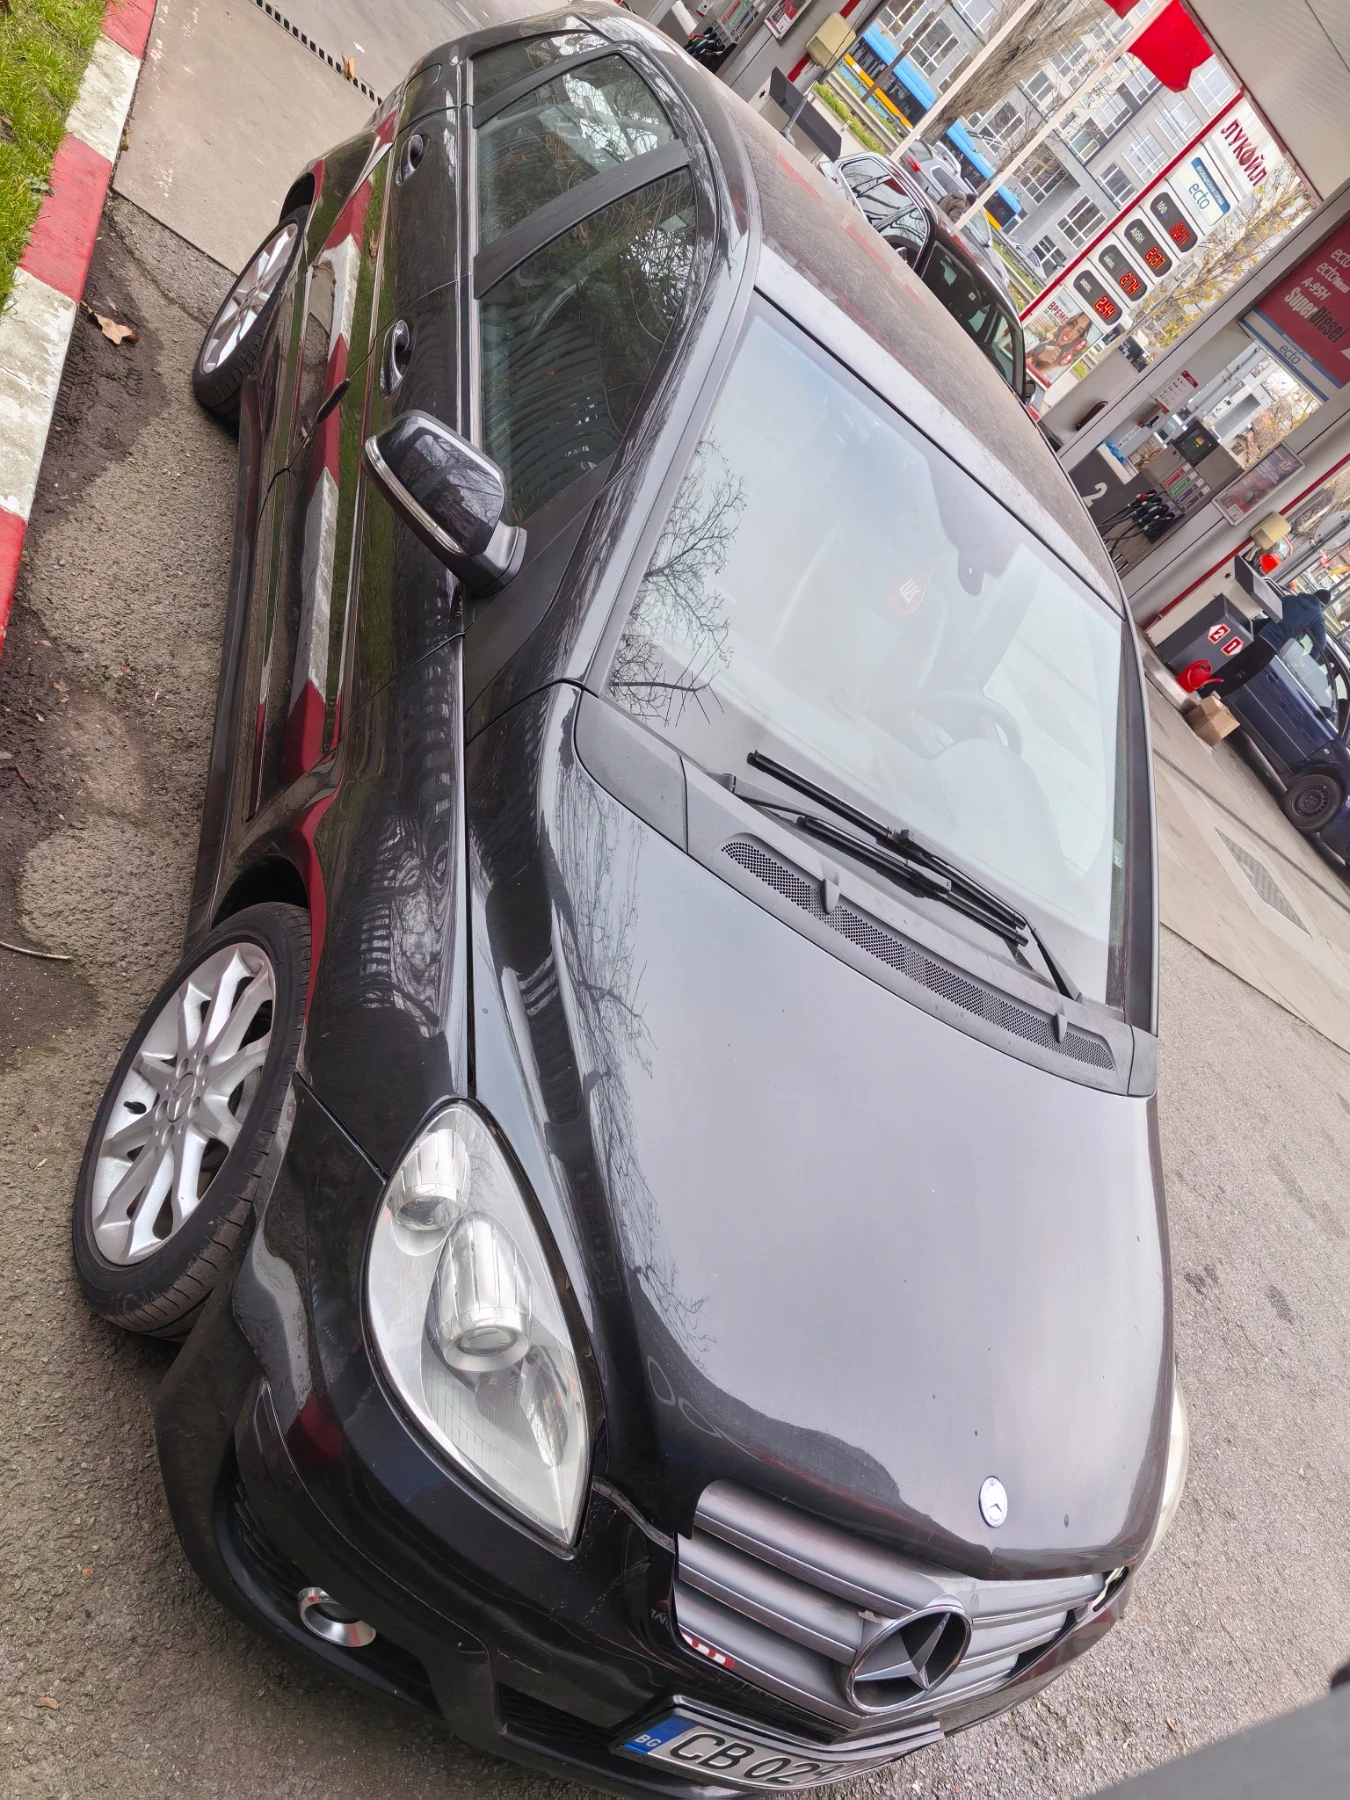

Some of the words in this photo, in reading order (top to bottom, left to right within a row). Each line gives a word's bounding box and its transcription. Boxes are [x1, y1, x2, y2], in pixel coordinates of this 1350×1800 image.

[1221, 118, 1267, 187] ЛУКОЙЛ
[1188, 182, 1210, 210] ecto
[1156, 201, 1168, 214] 100
[1279, 344, 1301, 365] ecto
[1280, 460, 1292, 471] STP
[1082, 482, 1108, 506] 2
[1213, 629, 1225, 640] 2
[1227, 642, 1238, 652] 1
[633, 1734, 661, 1748] BG
